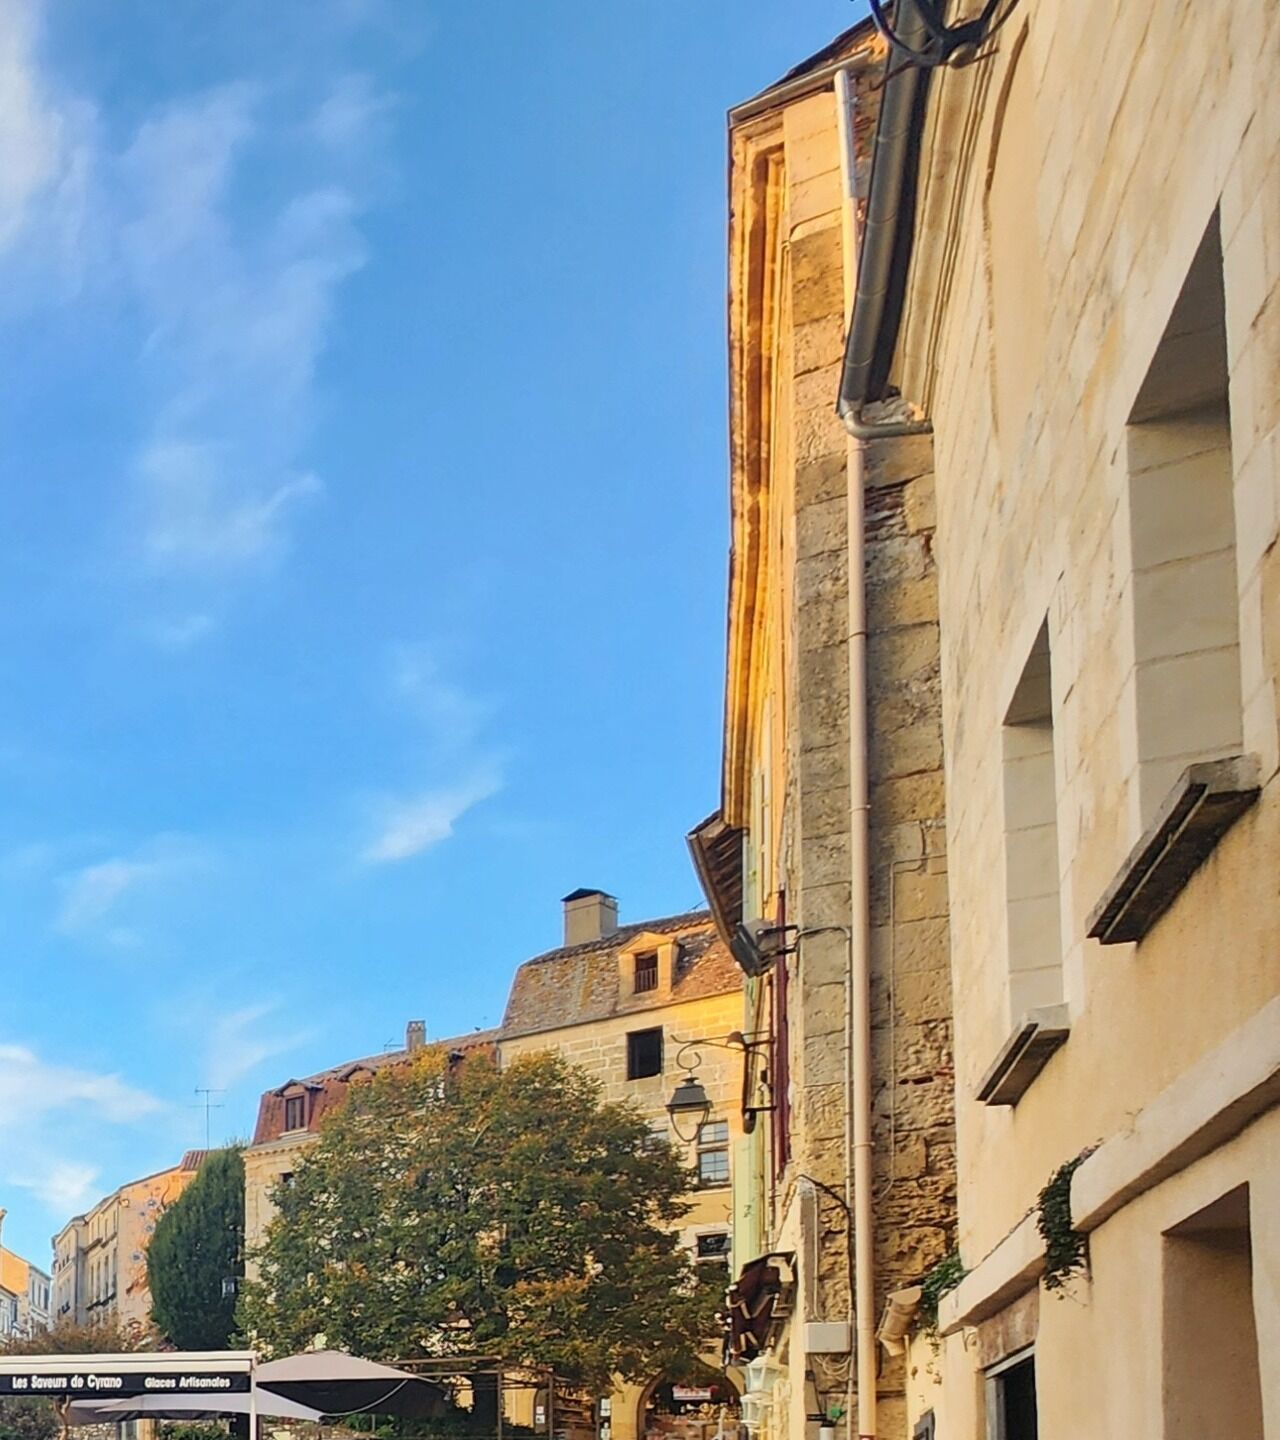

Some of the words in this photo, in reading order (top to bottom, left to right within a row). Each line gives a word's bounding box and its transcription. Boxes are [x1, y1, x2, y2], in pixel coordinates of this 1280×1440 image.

[12, 1376, 28, 1389] Les
[31, 1375, 68, 1388] Saveurs
[70, 1375, 84, 1388] de
[87, 1375, 123, 1390] Cyrano
[144, 1376, 176, 1388] Glaces
[179, 1375, 231, 1388] Artisanales
